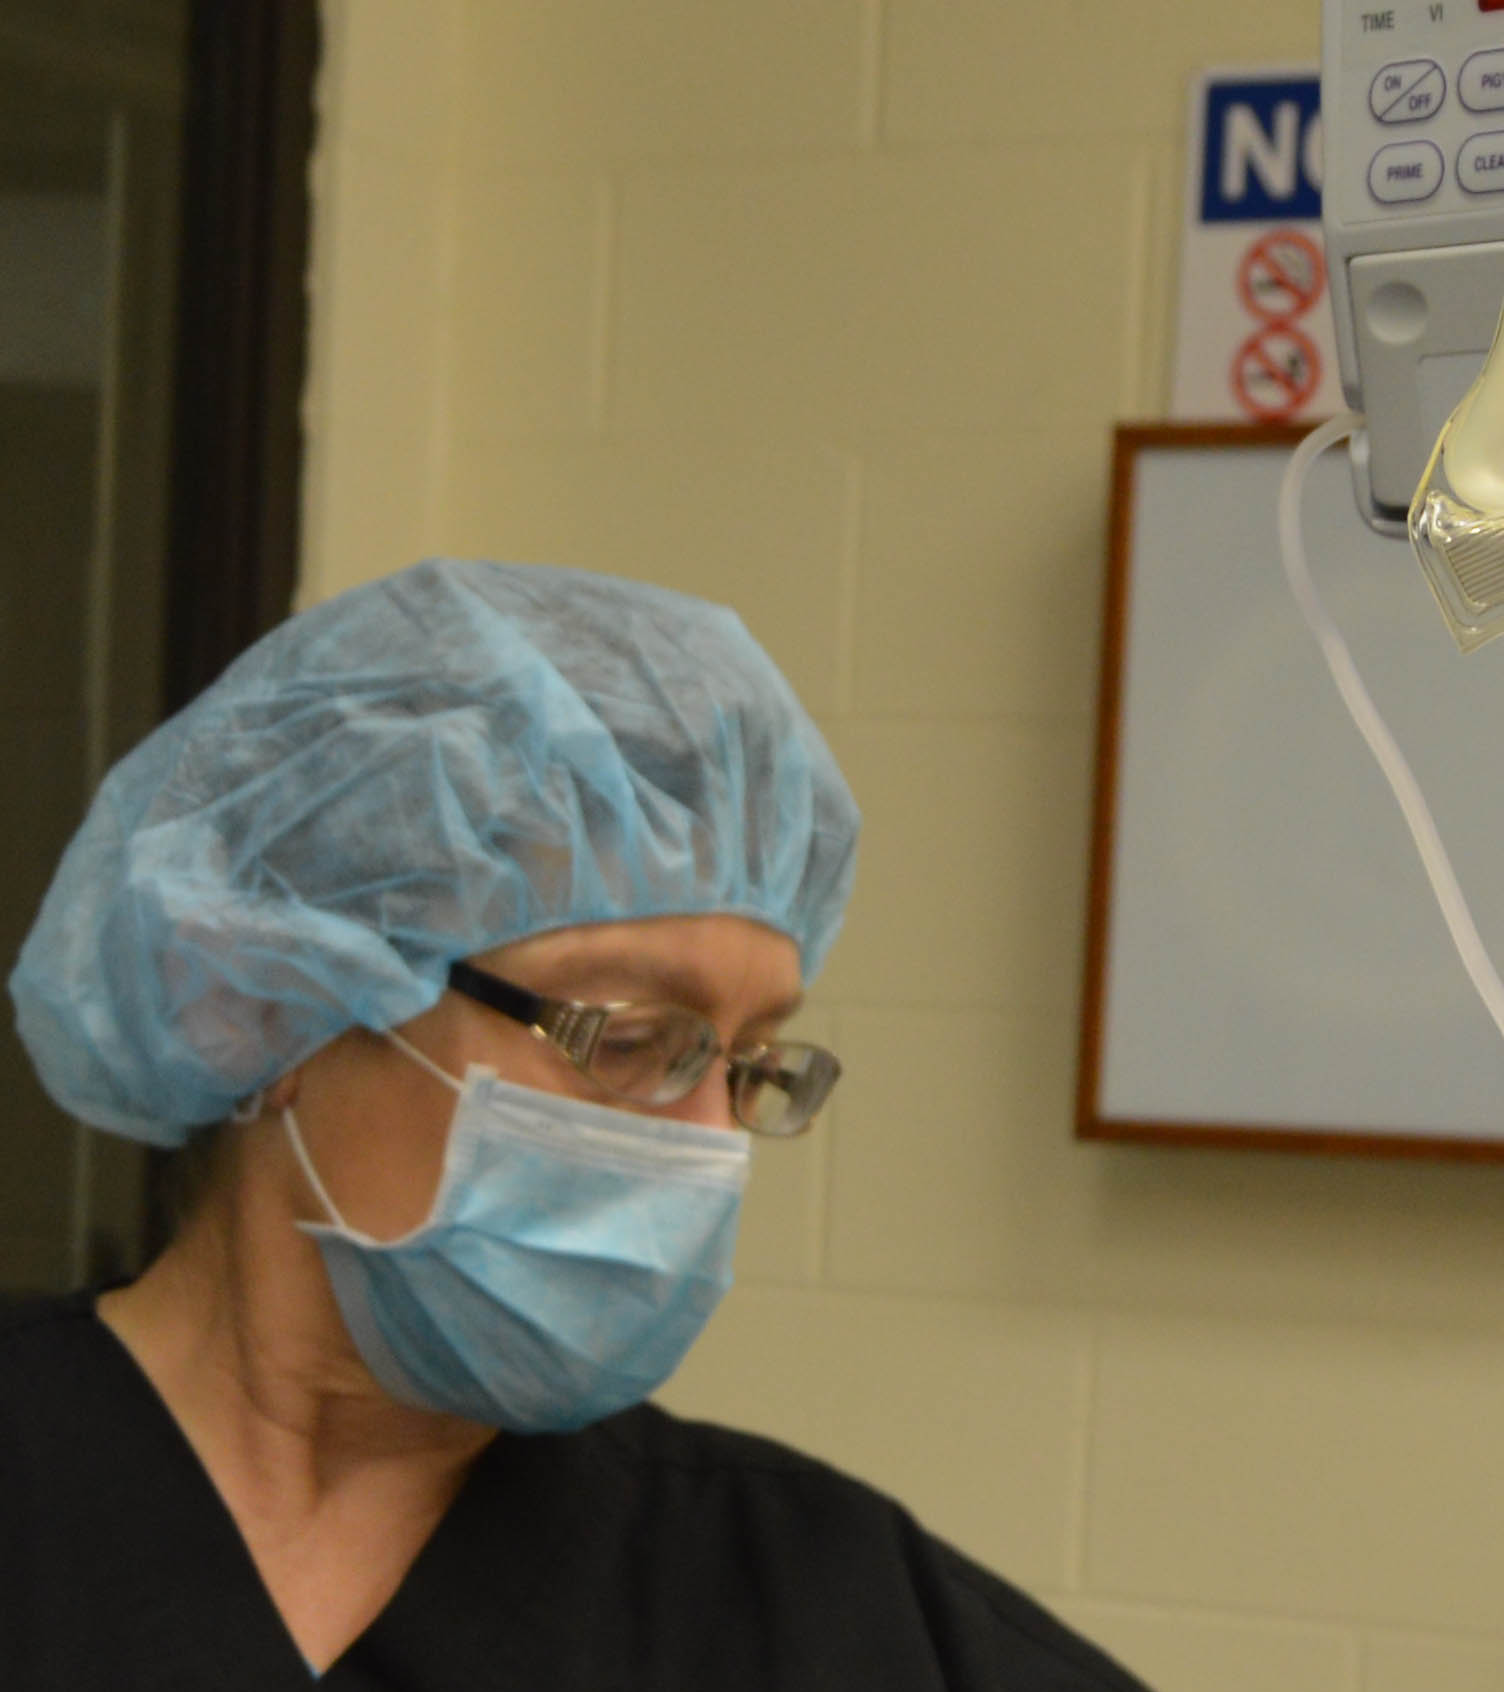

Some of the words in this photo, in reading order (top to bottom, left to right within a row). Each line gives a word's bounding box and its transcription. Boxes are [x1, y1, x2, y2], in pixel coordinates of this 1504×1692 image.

[1361, 10, 1395, 32] TIME
[1384, 76, 1402, 91] ON
[1409, 94, 1431, 111] OFF
[1386, 164, 1423, 182] PRIME
